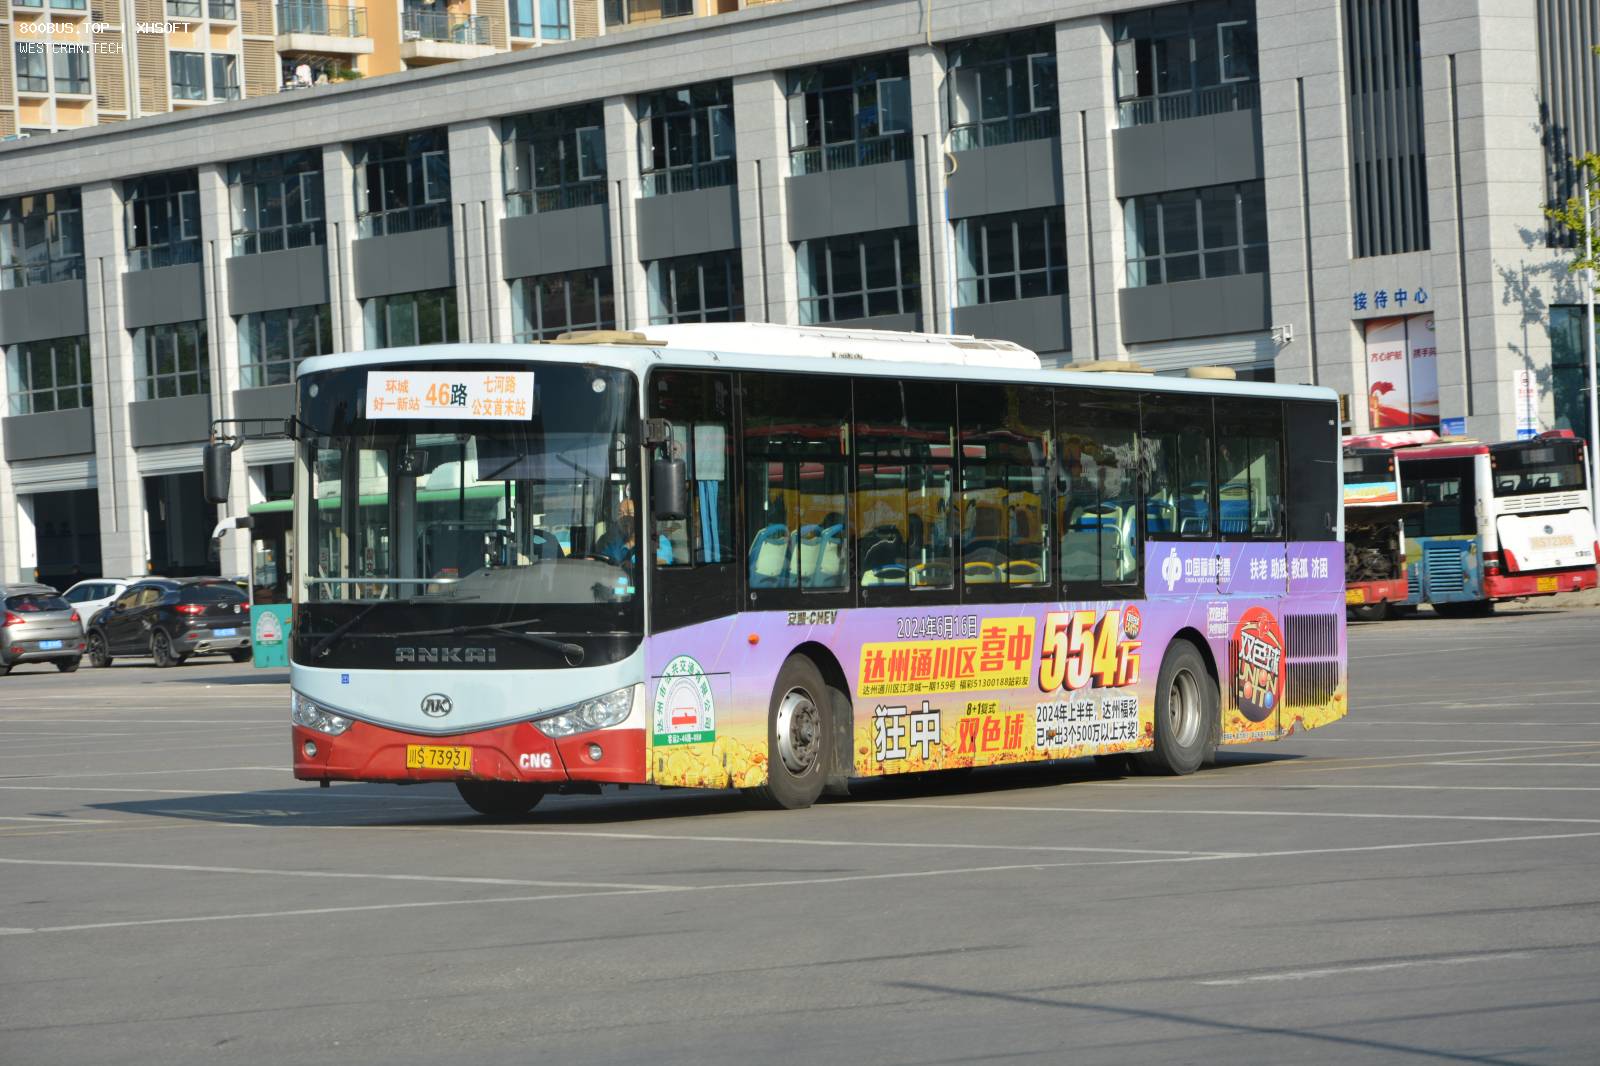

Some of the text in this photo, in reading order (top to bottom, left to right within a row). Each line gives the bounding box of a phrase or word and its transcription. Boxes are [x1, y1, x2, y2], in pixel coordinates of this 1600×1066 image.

[1353, 287, 1428, 311] 接待中心
[385, 379, 410, 394] 环城
[425, 383, 468, 407] 46路
[483, 375, 516, 394] 七河路
[373, 397, 420, 412] 好一新站
[472, 399, 527, 416] 公交首末站
[1250, 558, 1268, 580] 扶老
[1291, 558, 1309, 580] 救孤
[1311, 557, 1328, 579] 济困
[897, 614, 978, 639] 2024年6月16日
[395, 647, 497, 664] ANKAI
[863, 625, 1032, 684] 达州通川区 喜中
[1038, 610, 1142, 693] 554万
[1239, 629, 1281, 676] 双色球
[874, 700, 942, 762] 狂中
[958, 713, 1025, 754] 双色球
[519, 752, 553, 769] CNG
